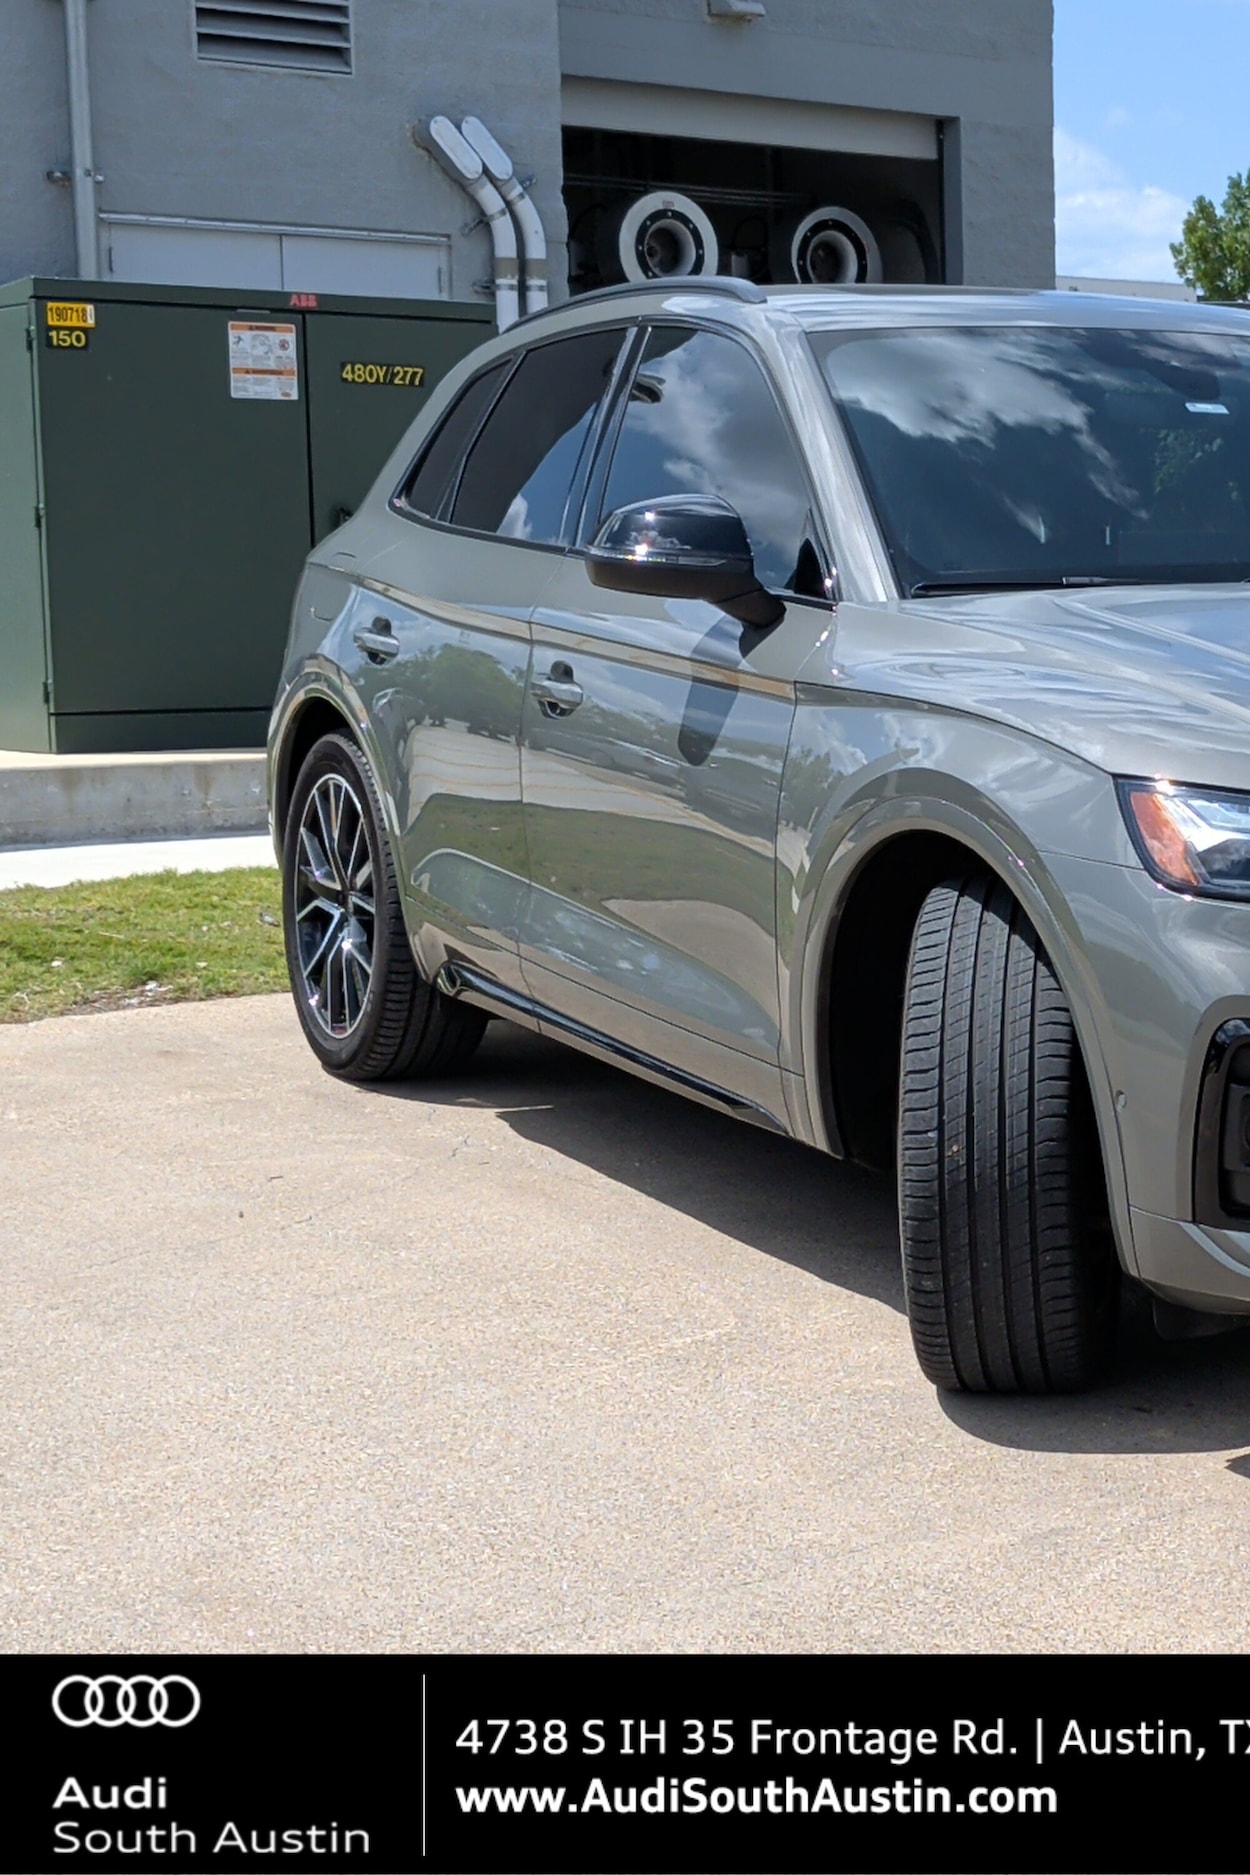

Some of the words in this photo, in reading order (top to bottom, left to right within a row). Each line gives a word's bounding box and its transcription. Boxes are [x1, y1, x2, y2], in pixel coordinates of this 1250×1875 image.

[290, 294, 317, 307] ABB
[48, 306, 88, 323] 190718
[49, 330, 86, 347] 150
[342, 363, 424, 386] 480Y/277
